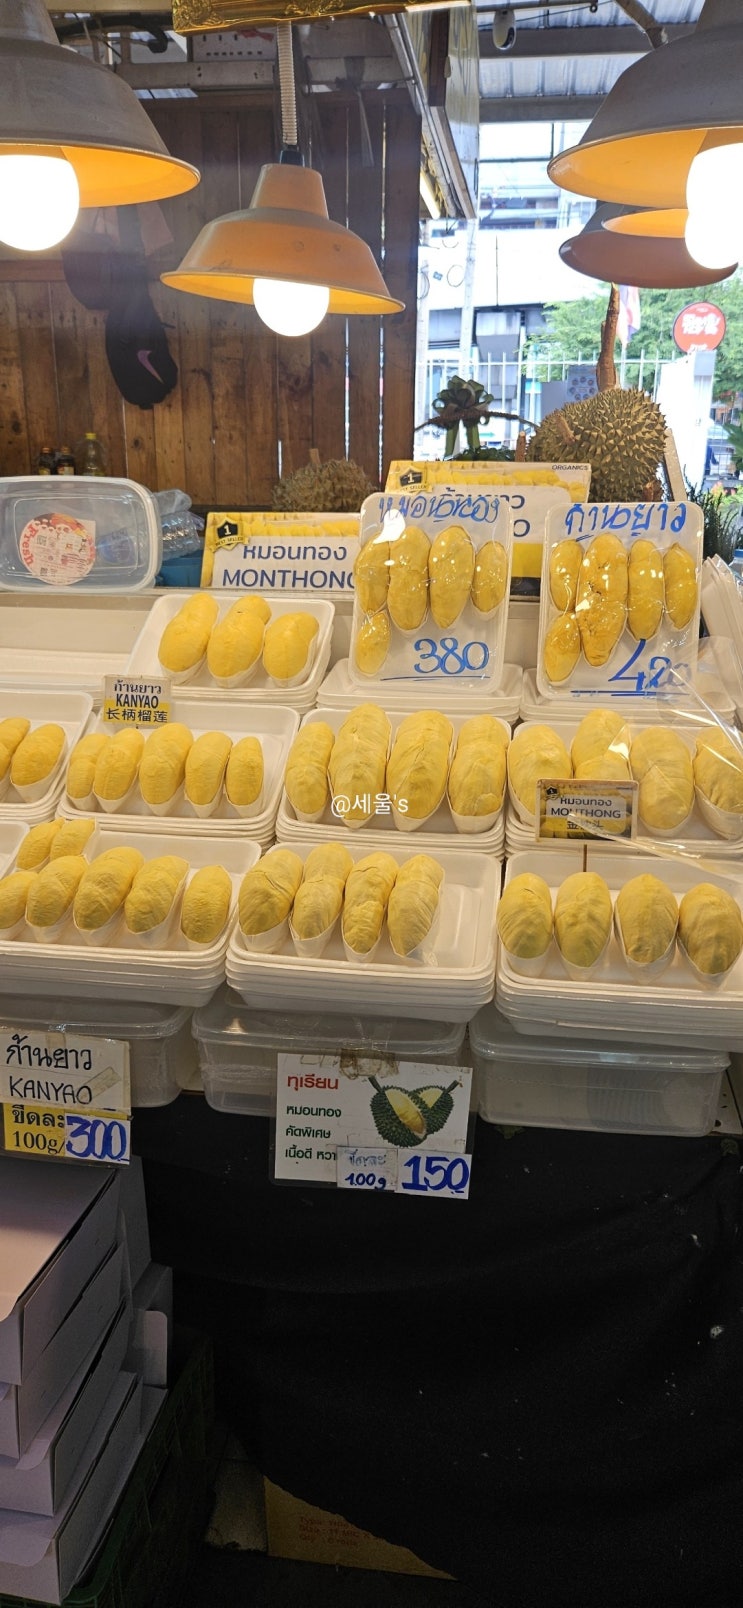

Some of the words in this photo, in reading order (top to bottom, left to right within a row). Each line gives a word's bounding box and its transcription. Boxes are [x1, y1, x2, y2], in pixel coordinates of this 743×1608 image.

[407, 473, 415, 483] 1
[223, 524, 232, 536] 1
[243, 545, 347, 560] หมอนทอง
[413, 637, 490, 674] 380
[607, 639, 692, 692] 420
[114, 679, 162, 694] ก้านยาว
[116, 694, 159, 709] KANYAO
[106, 708, 168, 723] 长柄榴莲
[6, 1034, 92, 1071] ก้านยาว
[287, 1073, 339, 1092] ทุเรียน
[9, 1076, 93, 1105] KANYAO
[286, 1104, 342, 1118] หมอนทอง
[285, 1125, 331, 1139] คัดพิเศษ
[12, 1131, 65, 1155] 100g/
[285, 1144, 312, 1160] เนื้อดี
[401, 1155, 470, 1191] 150
